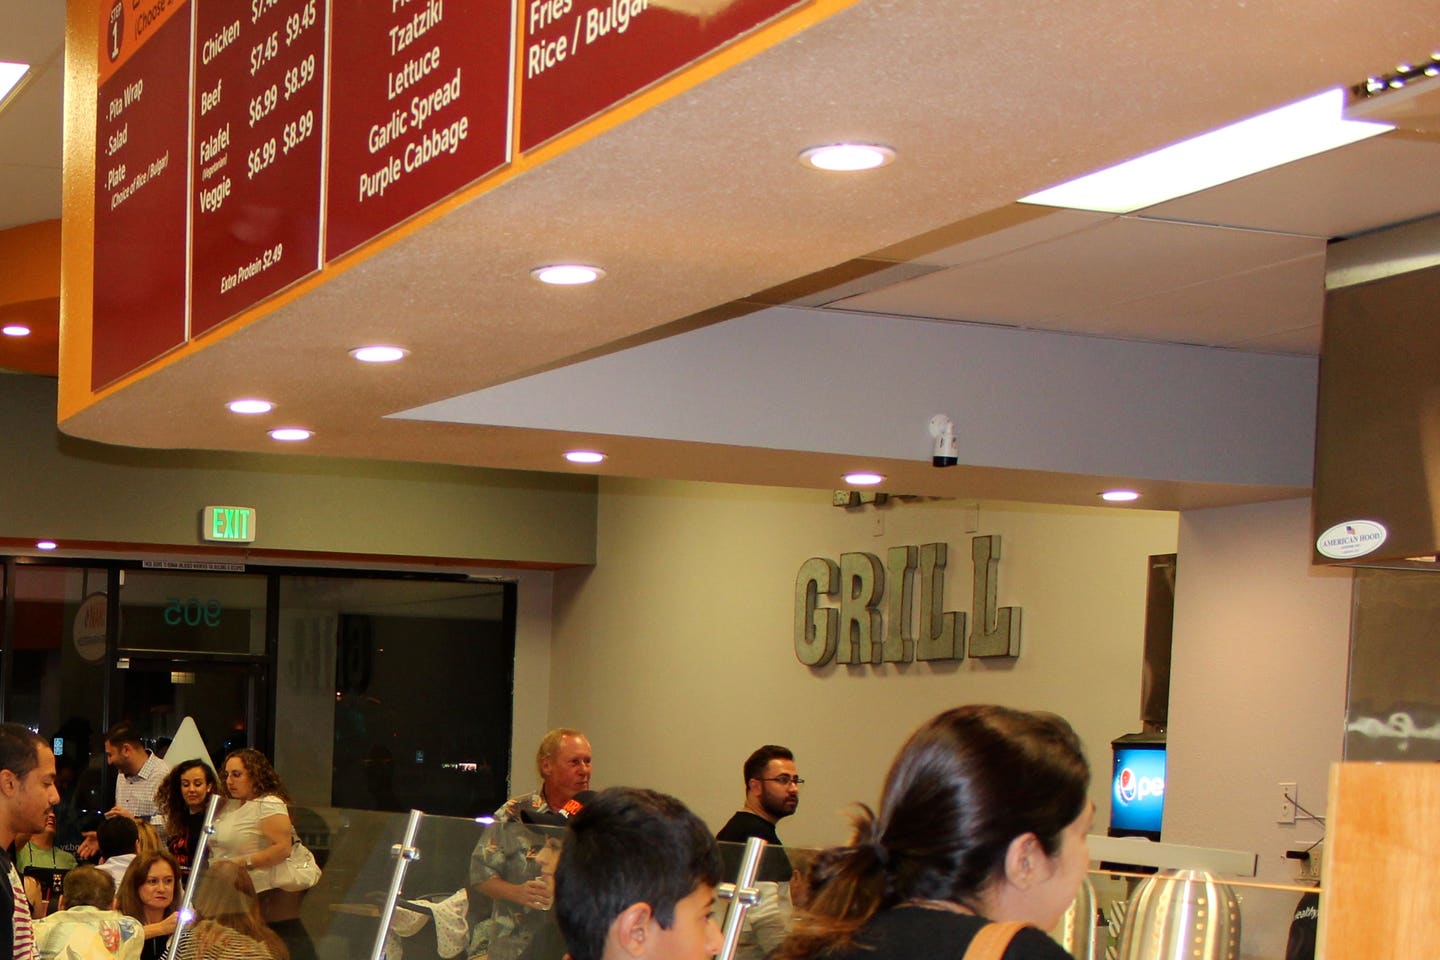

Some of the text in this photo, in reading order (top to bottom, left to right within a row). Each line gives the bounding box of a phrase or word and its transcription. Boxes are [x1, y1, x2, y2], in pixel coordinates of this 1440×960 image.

[111, 20, 119, 60] 1
[202, 0, 278, 65] Chicken $7.
[388, 0, 443, 56] Tzatziki
[529, 0, 573, 35] Fries
[201, 0, 316, 116] Beef $7.45 $9.45
[388, 45, 441, 101] Lettuce
[528, 35, 568, 79] Rice
[571, 14, 582, 56] /
[109, 78, 143, 123] Pita Wrap
[200, 53, 315, 166] Falafel $6.99 $8.99
[368, 66, 461, 154] Garlic Spread
[108, 122, 128, 156] Salad
[199, 109, 314, 214] Veggie $6.99 $8.99
[359, 116, 469, 203] Purple Cabbage
[108, 164, 127, 191] Plate
[220, 274, 238, 294] Extra
[238, 257, 262, 284] Protein
[212, 508, 250, 539] EXIT
[1323, 536, 1358, 547] AMERICAN
[1359, 533, 1380, 541] HOOD
[794, 535, 1022, 667] GRILL
